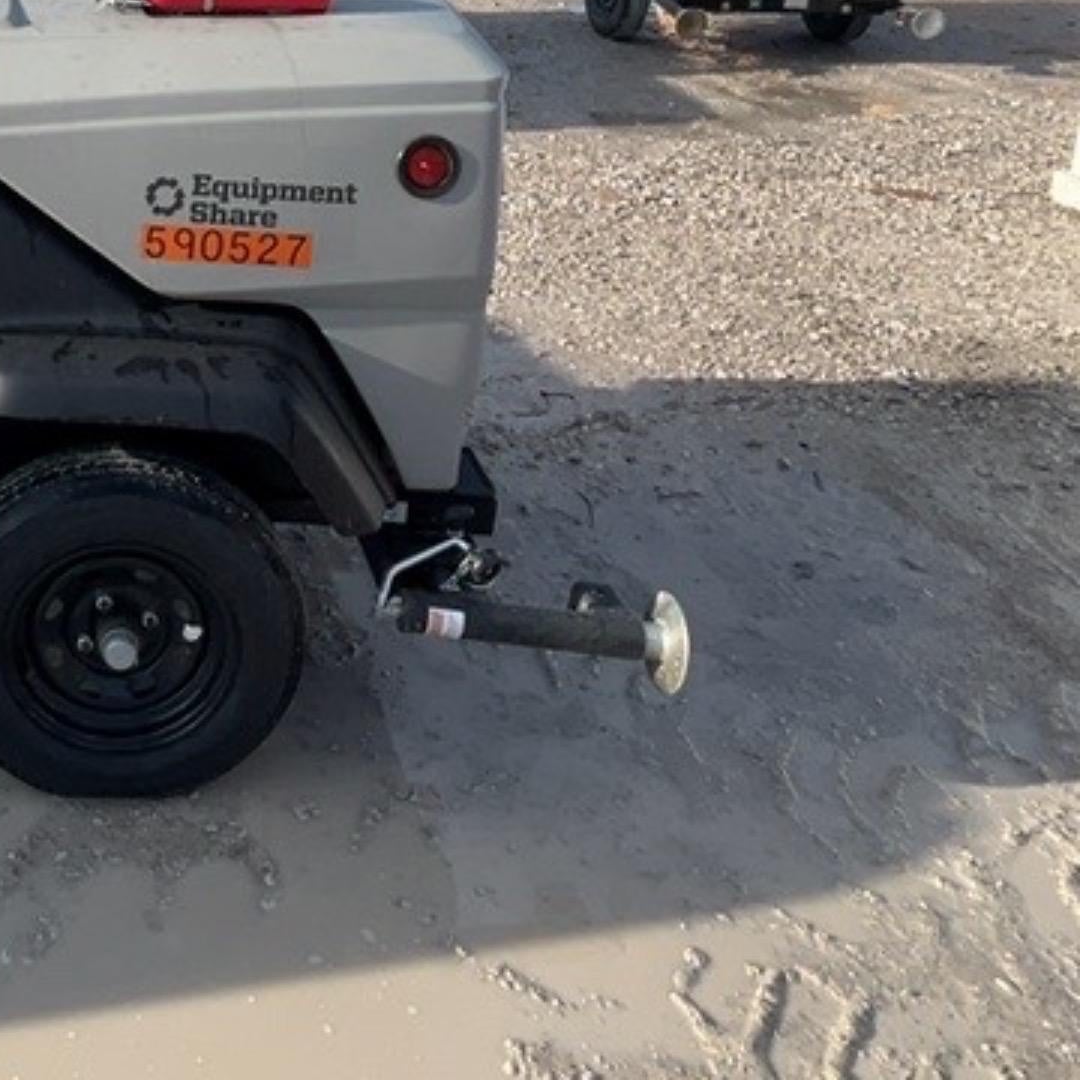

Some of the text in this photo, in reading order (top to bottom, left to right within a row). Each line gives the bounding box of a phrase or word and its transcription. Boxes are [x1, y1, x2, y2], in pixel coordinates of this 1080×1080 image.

[191, 174, 358, 205] Equipment
[189, 201, 279, 228] Share
[145, 225, 308, 268] 590527
